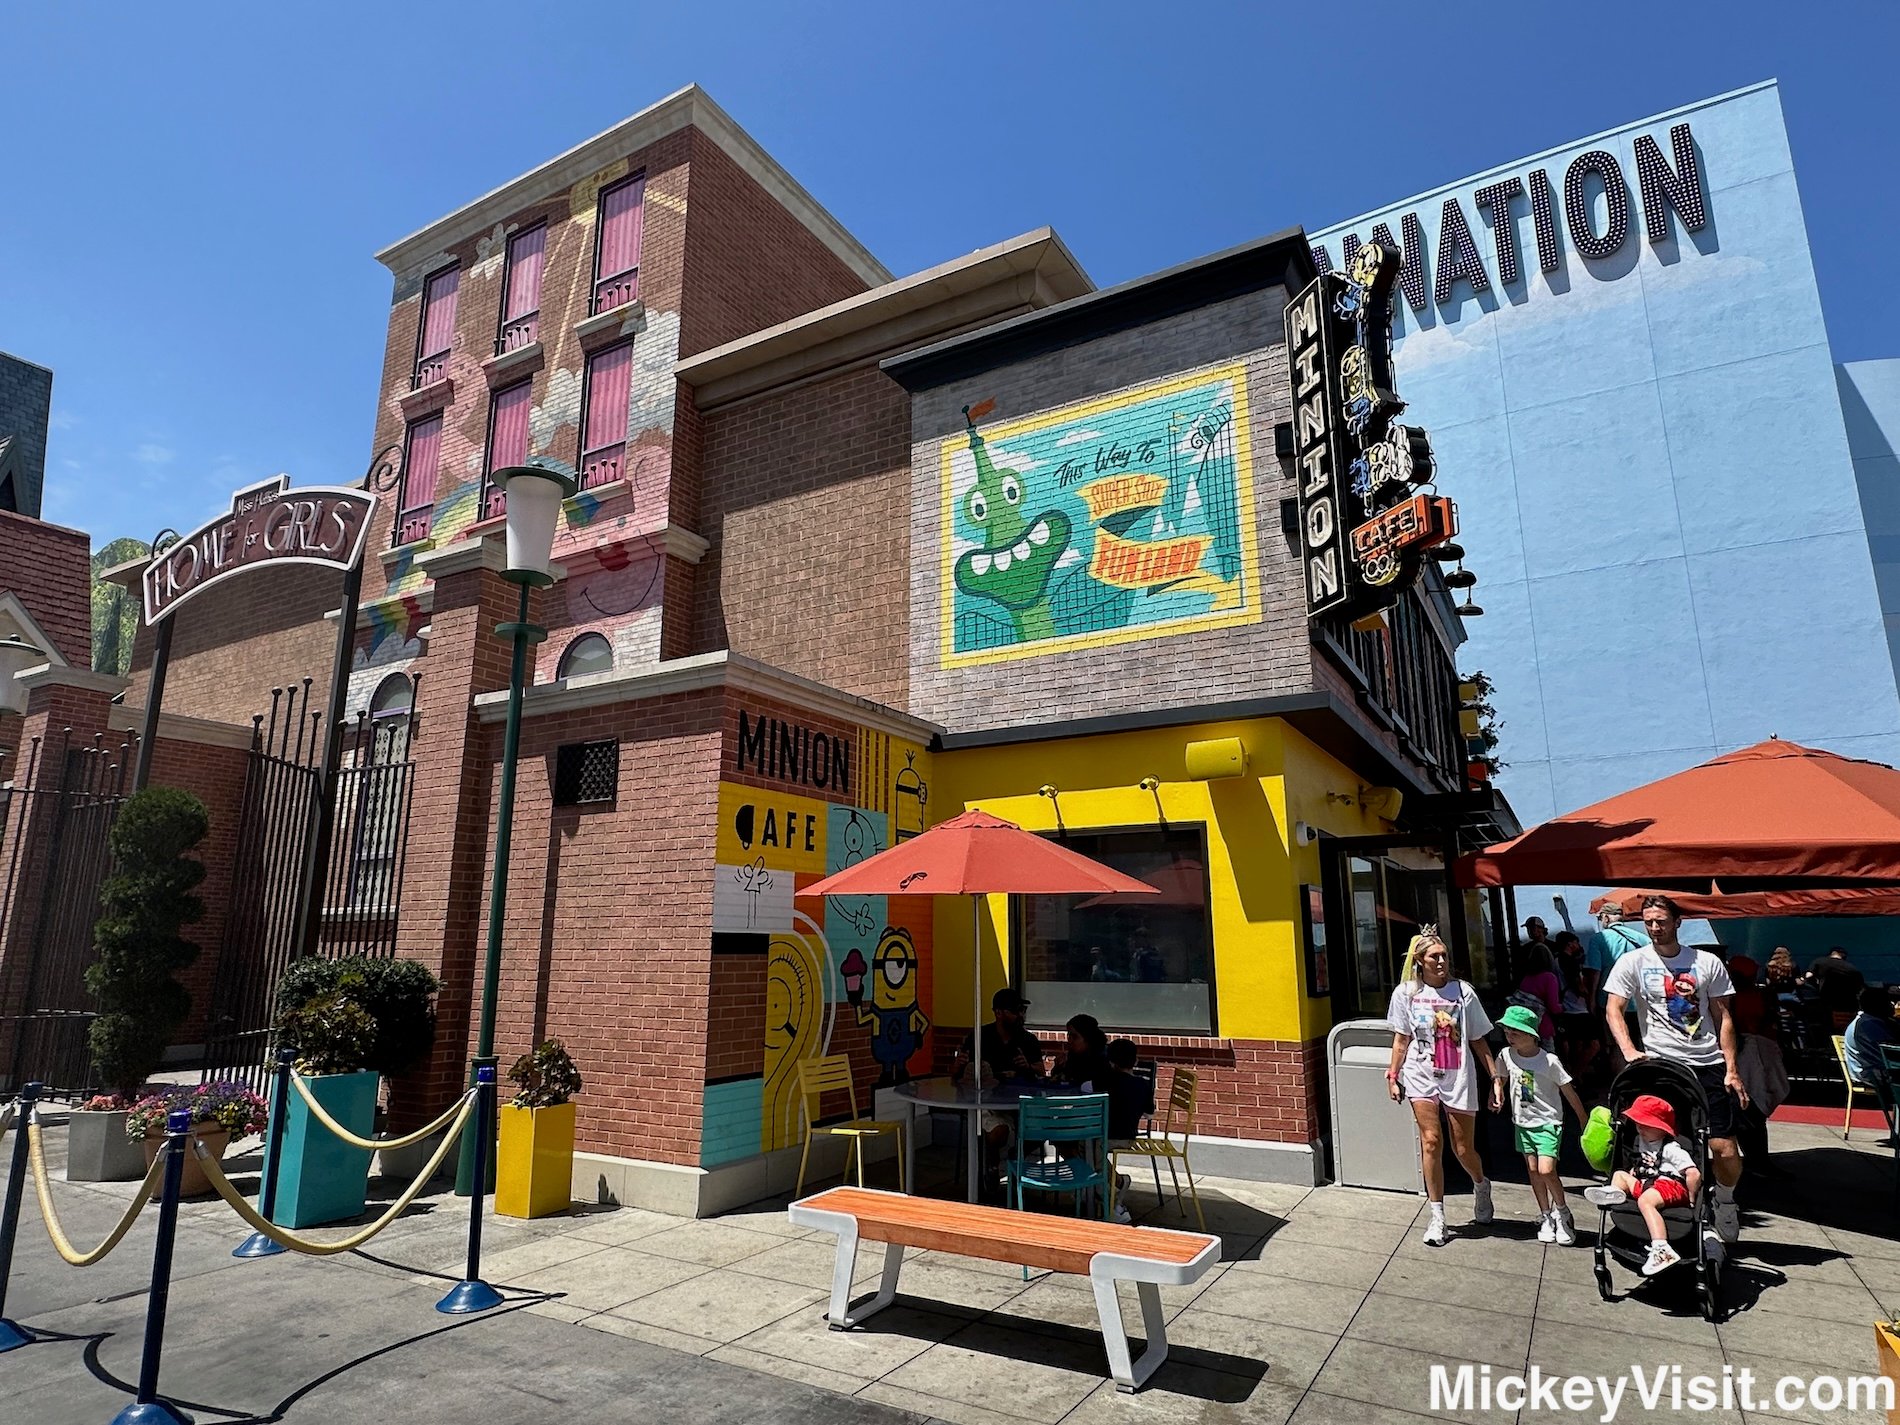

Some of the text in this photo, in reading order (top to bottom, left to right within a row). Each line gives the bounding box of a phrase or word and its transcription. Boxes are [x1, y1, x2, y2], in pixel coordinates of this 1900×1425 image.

[1053, 438, 1162, 489] This Way To
[1290, 290, 1338, 604] MINION
[153, 519, 237, 608] HOME
[241, 519, 260, 559] for
[263, 499, 353, 553] GIRLS
[1356, 506, 1414, 552] CAFE
[737, 708, 850, 794] MINION
